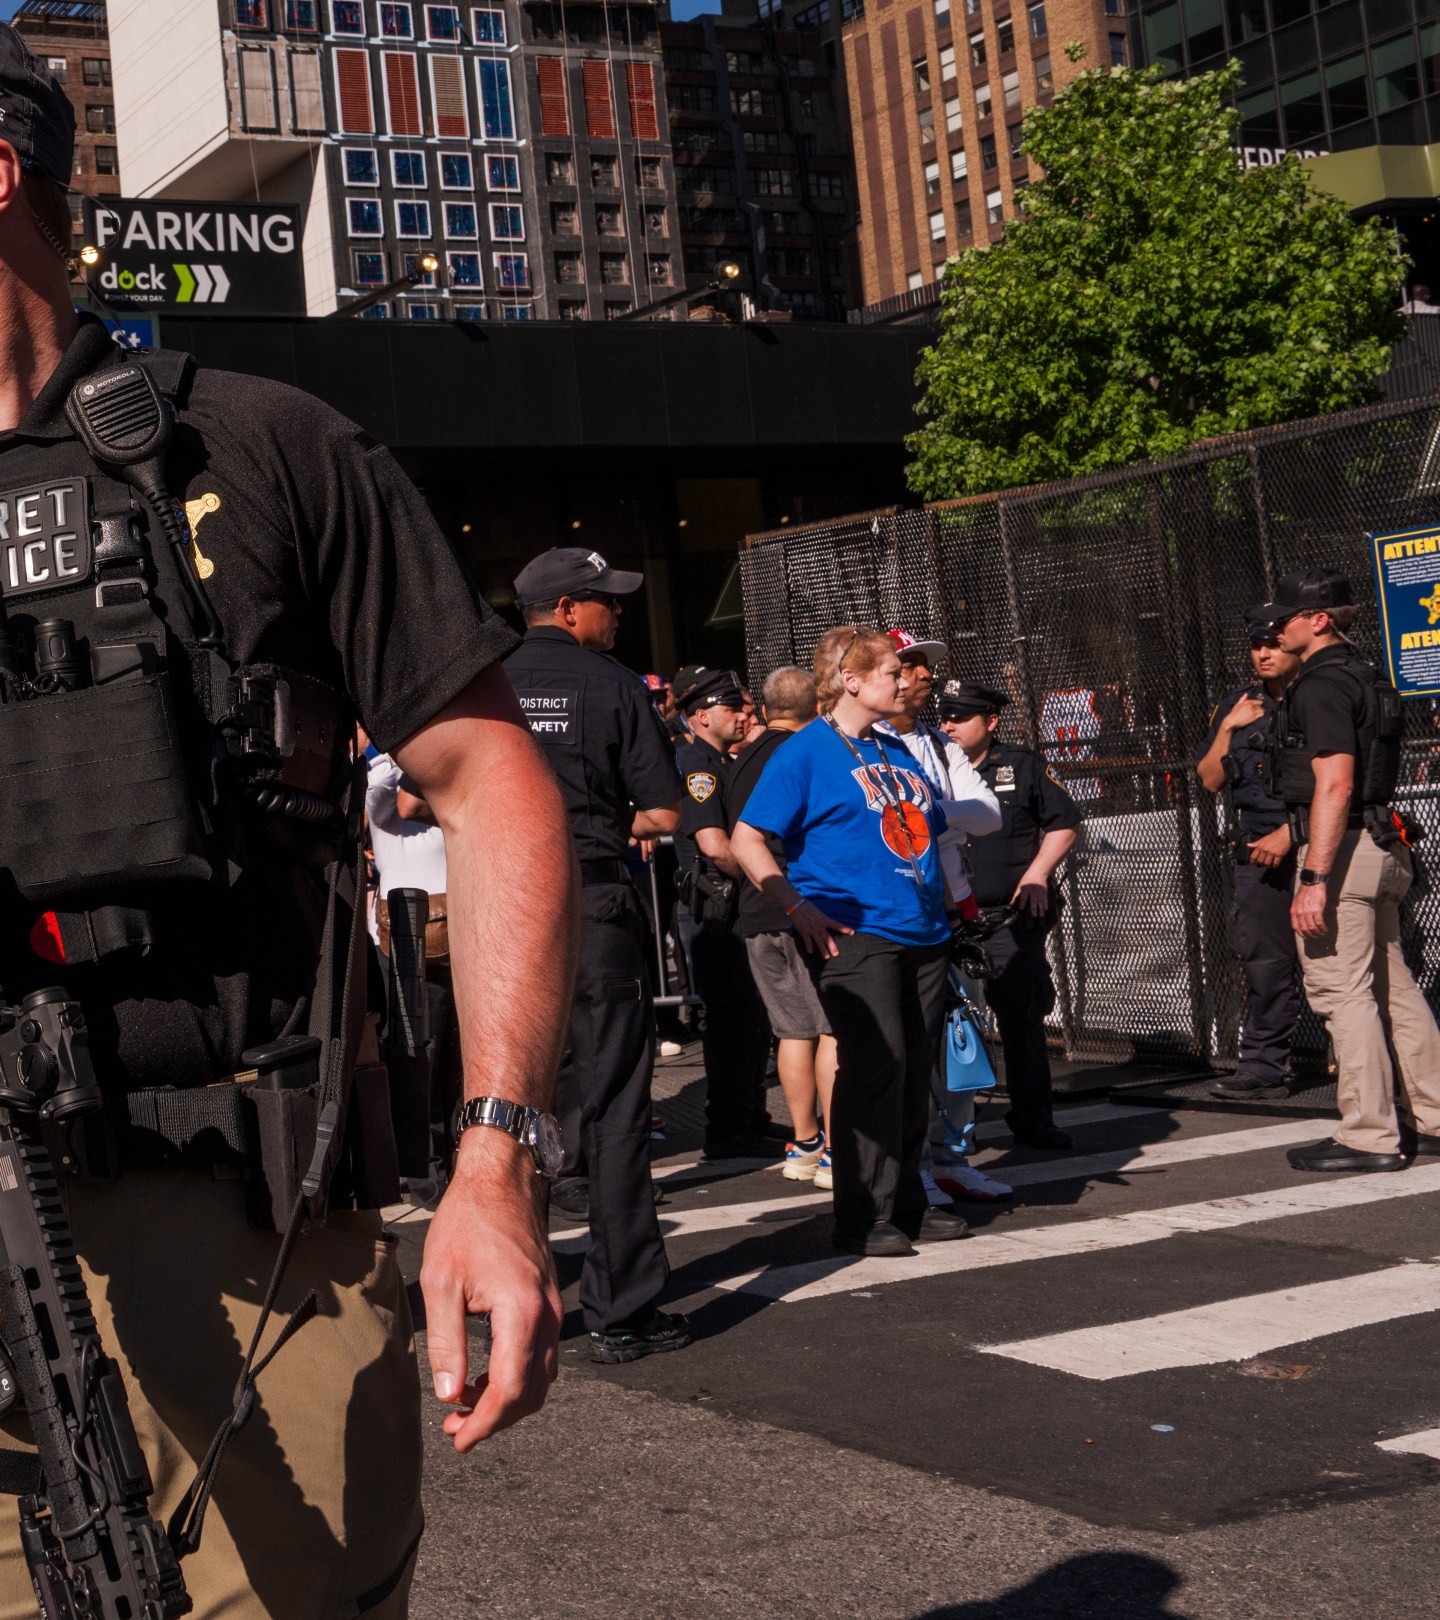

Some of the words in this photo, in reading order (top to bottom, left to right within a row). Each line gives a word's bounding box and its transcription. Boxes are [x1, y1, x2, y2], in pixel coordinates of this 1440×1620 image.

[96, 210, 294, 253] PARKING
[100, 263, 166, 290] dock
[130, 294, 148, 302] YOUR
[96, 370, 135, 388] MOTOROLA
[520, 698, 568, 709] DISTRICT
[529, 721, 569, 732] AFETY
